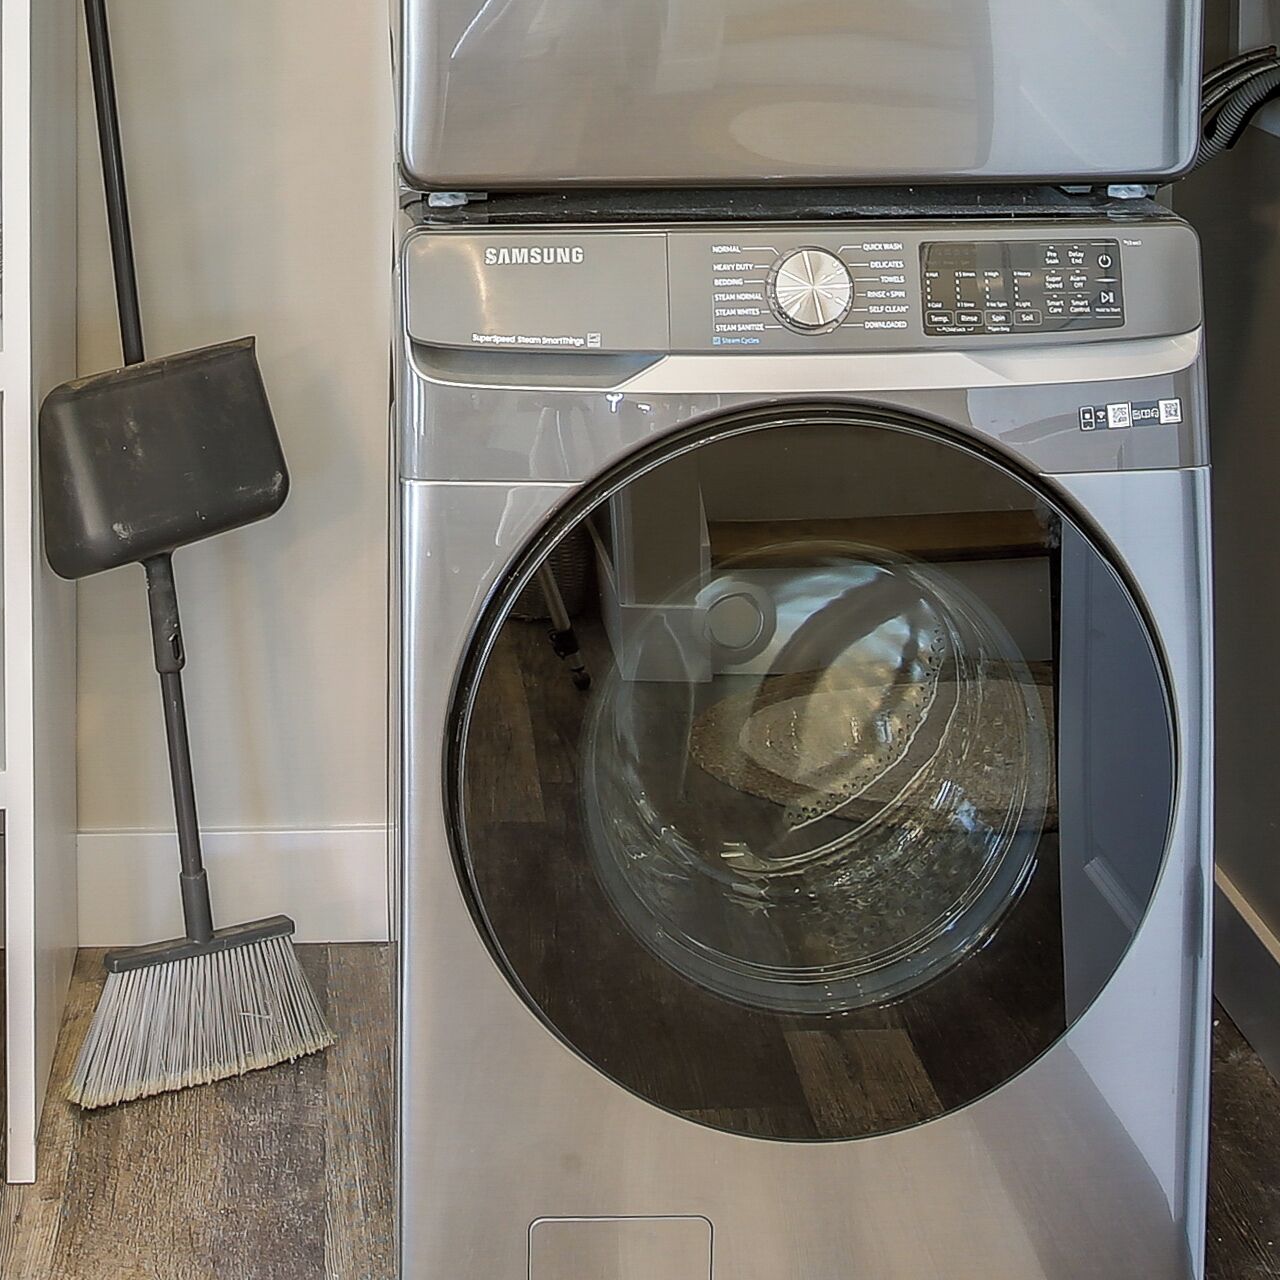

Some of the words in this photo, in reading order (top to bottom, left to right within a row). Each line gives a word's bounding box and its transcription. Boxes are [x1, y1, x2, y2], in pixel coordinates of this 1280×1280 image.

[711, 245, 741, 253] NORMAL
[484, 246, 585, 265] SAMSUNG
[712, 263, 736, 271] HEAVY
[735, 263, 754, 271] DUTY
[714, 293, 736, 301] STEAM
[714, 308, 737, 316] STEAM
[715, 323, 737, 332] STEAM
